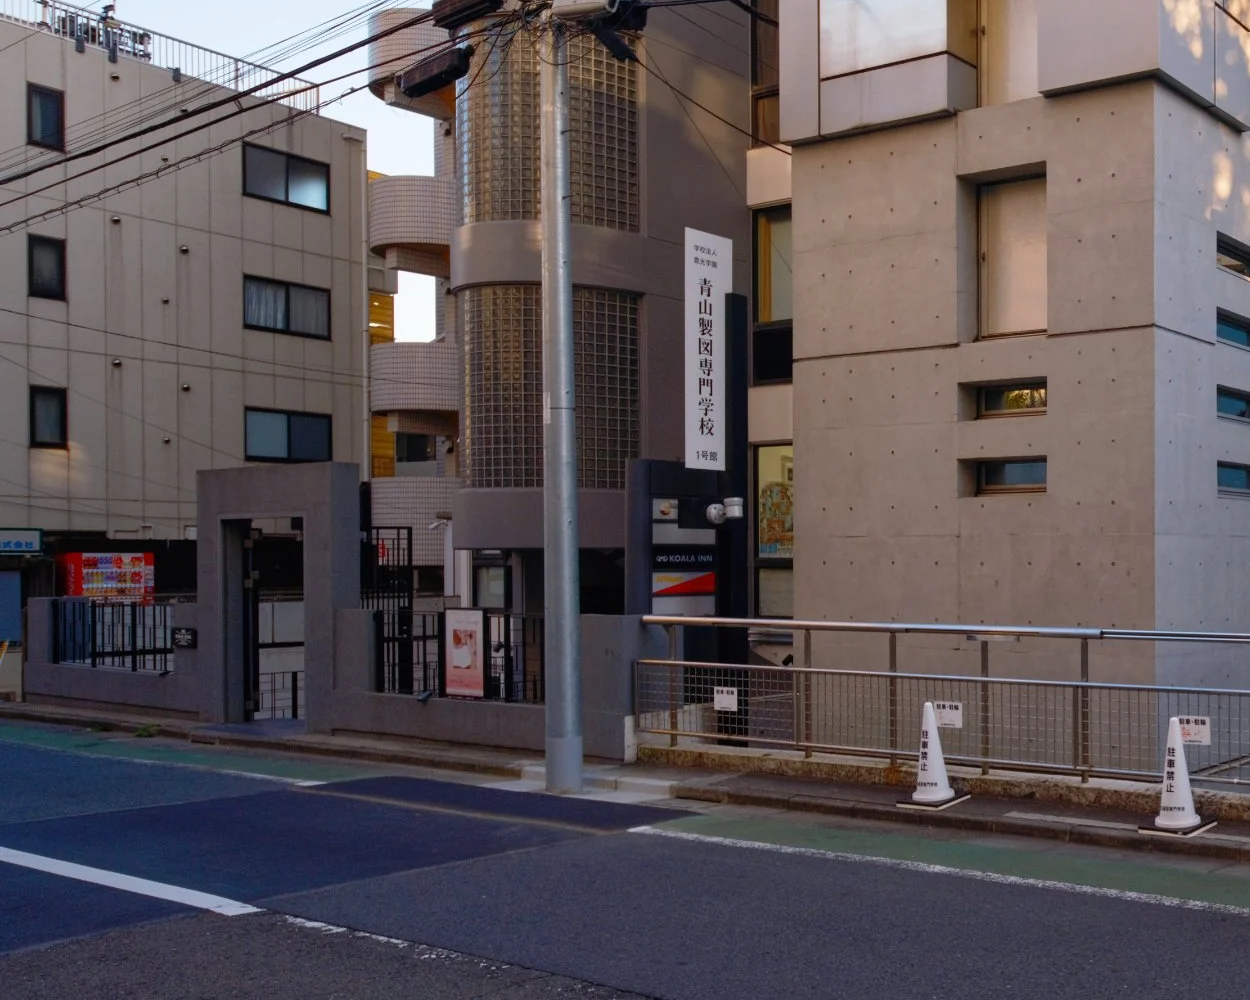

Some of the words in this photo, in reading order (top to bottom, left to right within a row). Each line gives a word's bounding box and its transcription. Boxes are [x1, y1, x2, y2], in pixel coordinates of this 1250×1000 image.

[693, 244, 718, 257] 学校法人
[698, 277, 715, 437] 青山製図専門学校
[696, 450, 718, 462] 1号館
[1167, 747, 1175, 792] 駐車禁止
